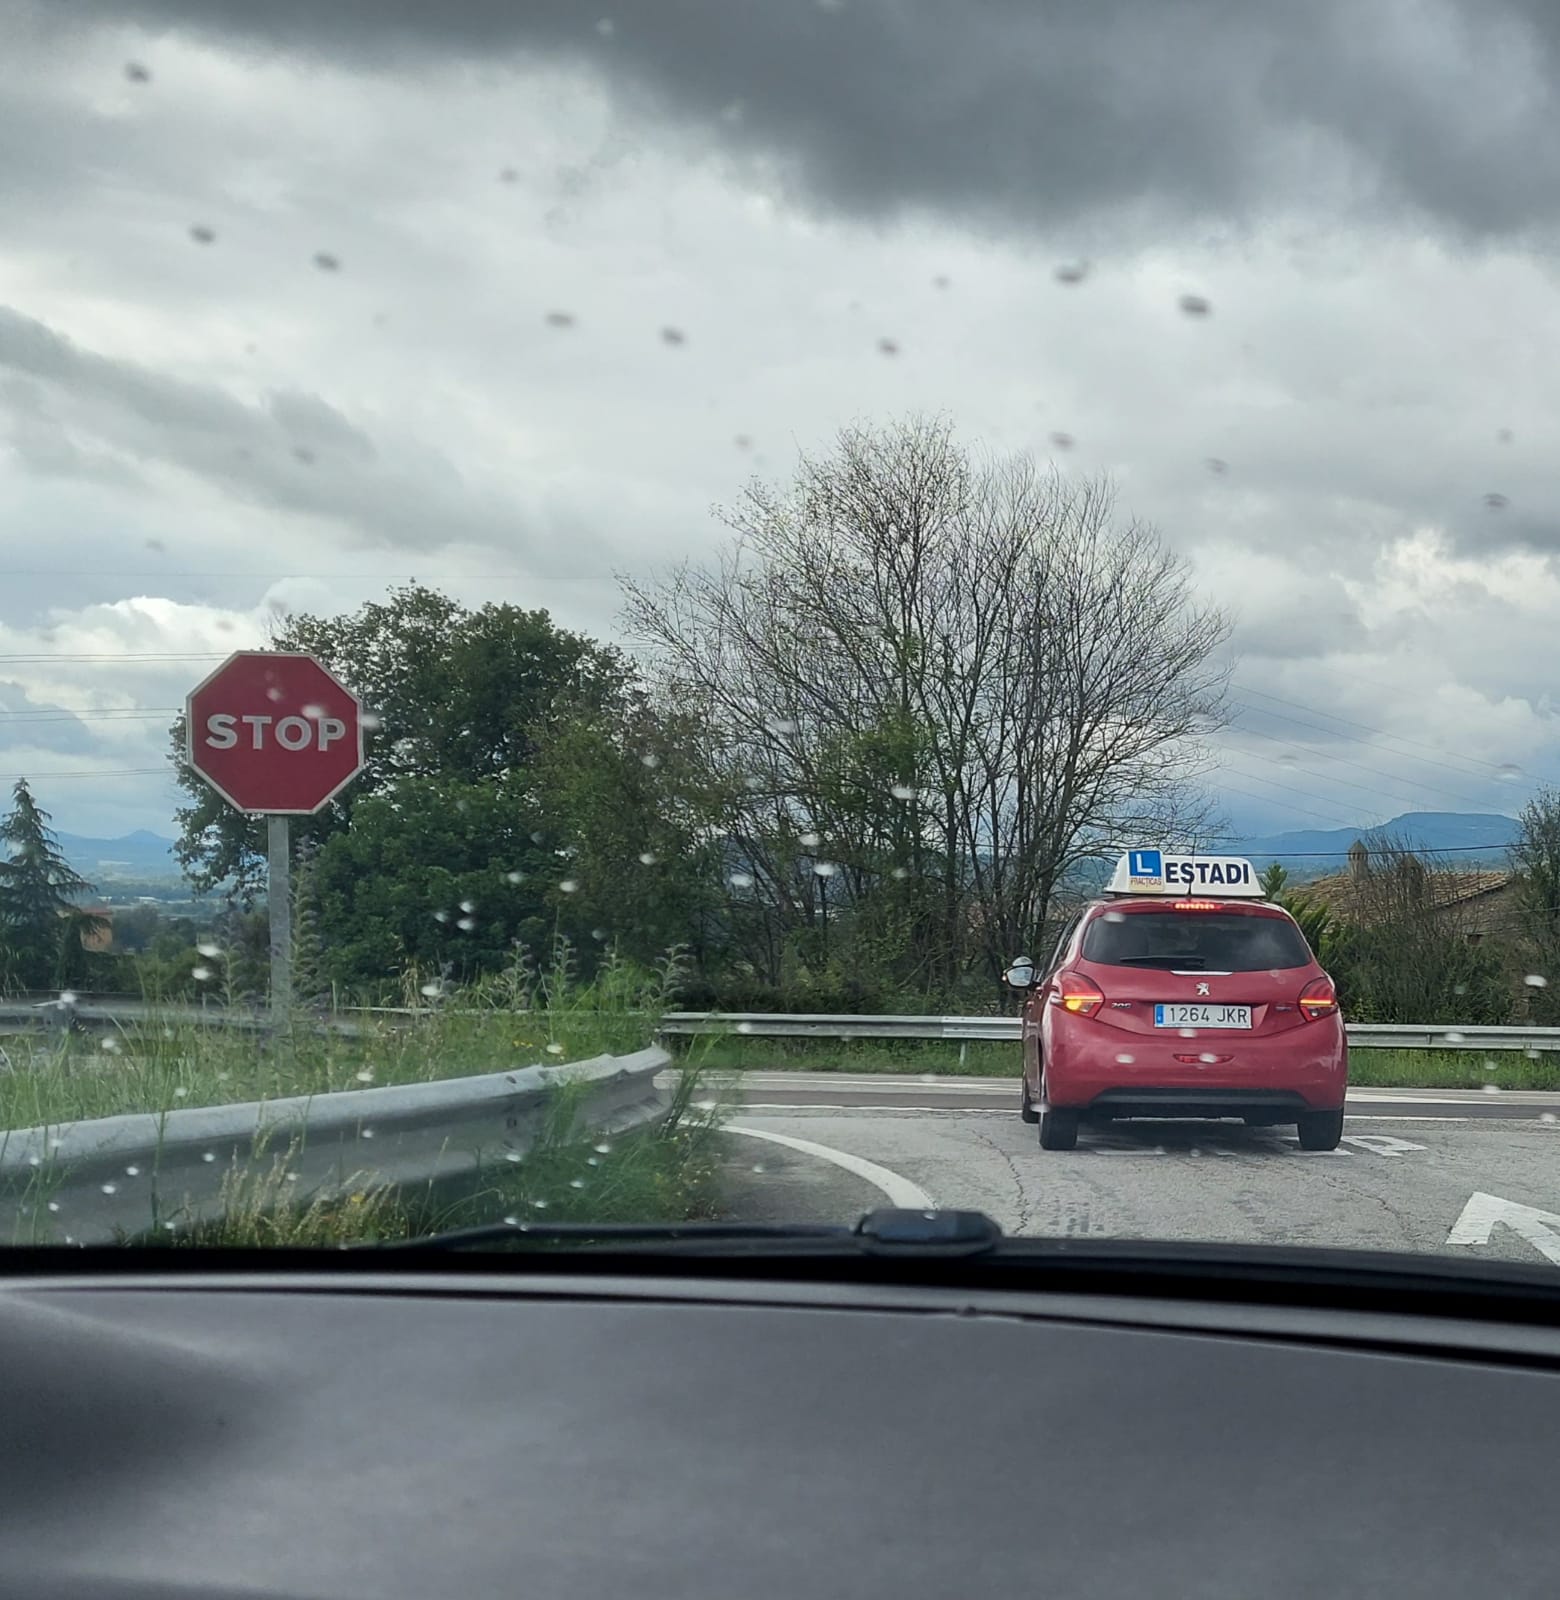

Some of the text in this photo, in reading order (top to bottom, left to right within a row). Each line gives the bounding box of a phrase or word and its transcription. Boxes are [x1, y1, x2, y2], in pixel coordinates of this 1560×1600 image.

[206, 713, 346, 751] STOP
[1136, 853, 1153, 873] L
[1165, 862, 1249, 884] ESTADI
[1170, 1007, 1210, 1022] 1264
[1216, 1007, 1248, 1024] JKR
